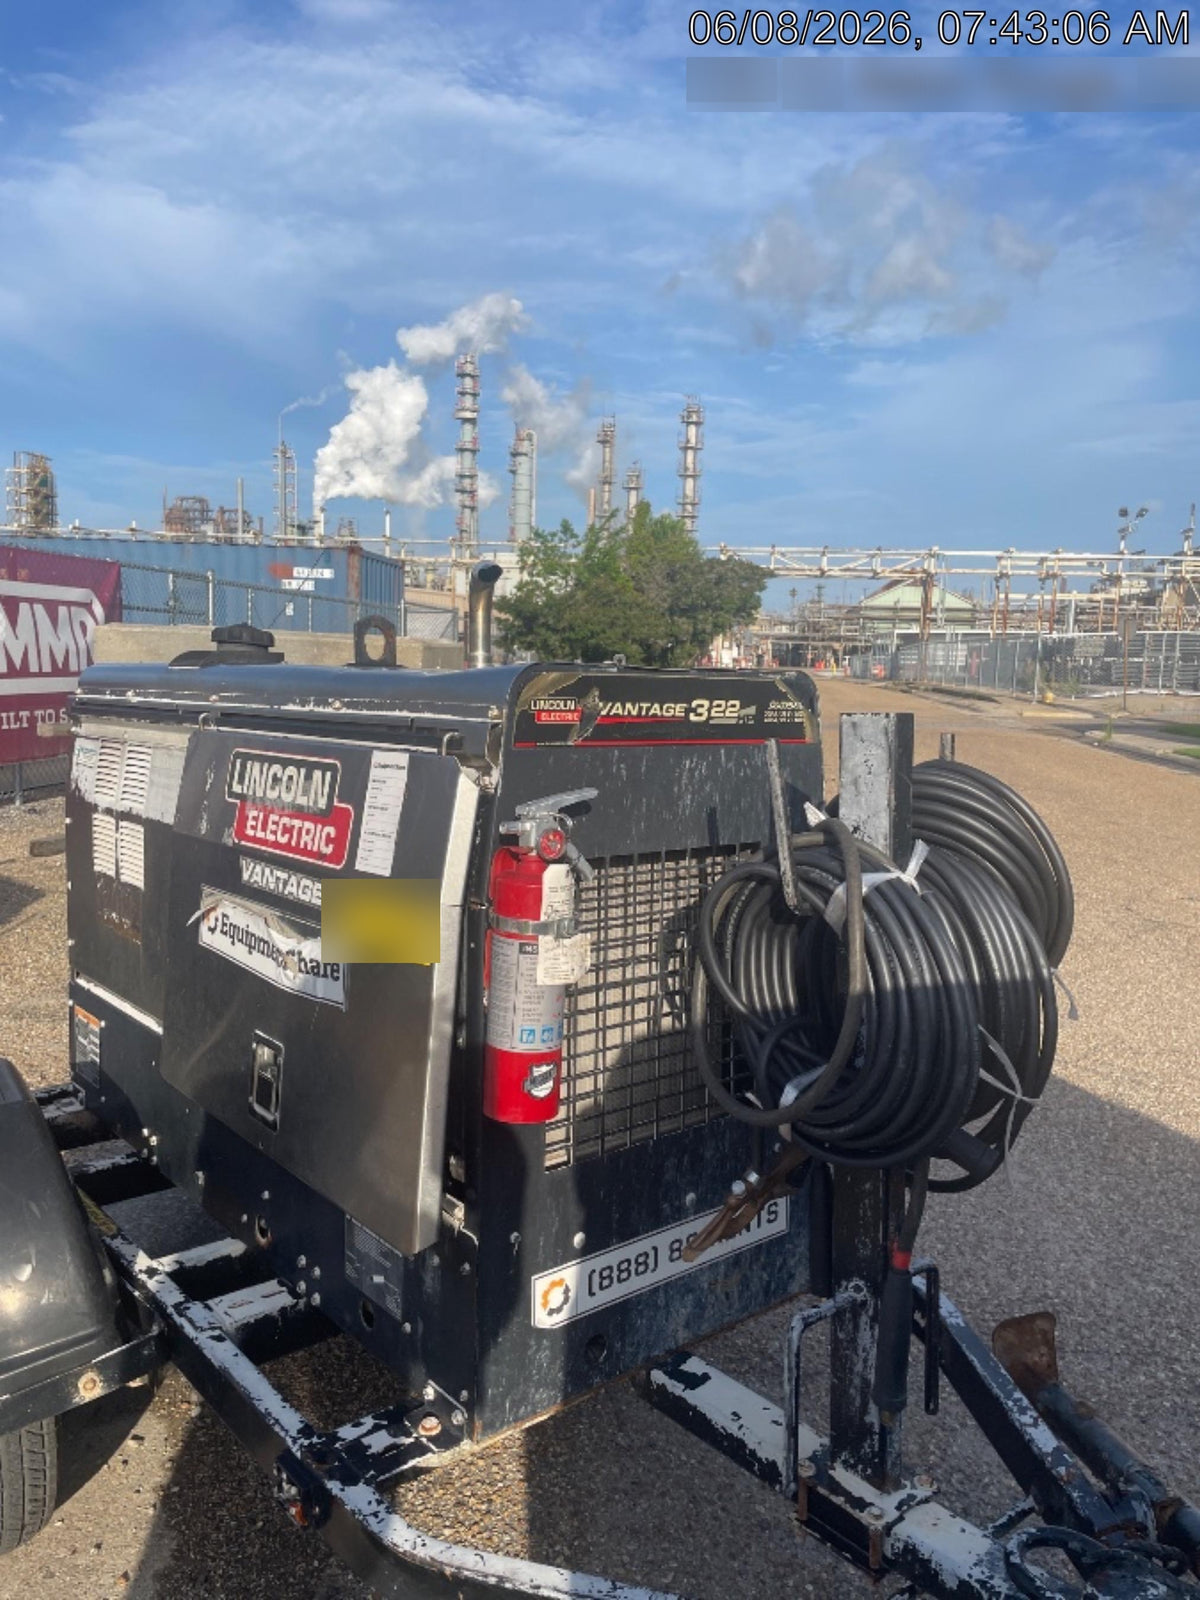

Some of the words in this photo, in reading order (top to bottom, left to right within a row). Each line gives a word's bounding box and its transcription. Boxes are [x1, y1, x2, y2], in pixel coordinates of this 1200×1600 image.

[34, 708, 56, 727] TO
[530, 699, 576, 711] LINCOLN
[540, 712, 579, 721] ELECTRIC
[599, 702, 687, 717] VANTAGE
[689, 698, 740, 723] 322
[231, 758, 332, 810] LINCOLN
[244, 810, 337, 855] ELECTRIC
[241, 858, 322, 906] VANTAGE
[219, 911, 342, 983] Equipmhare
[587, 1244, 659, 1297] (888)
